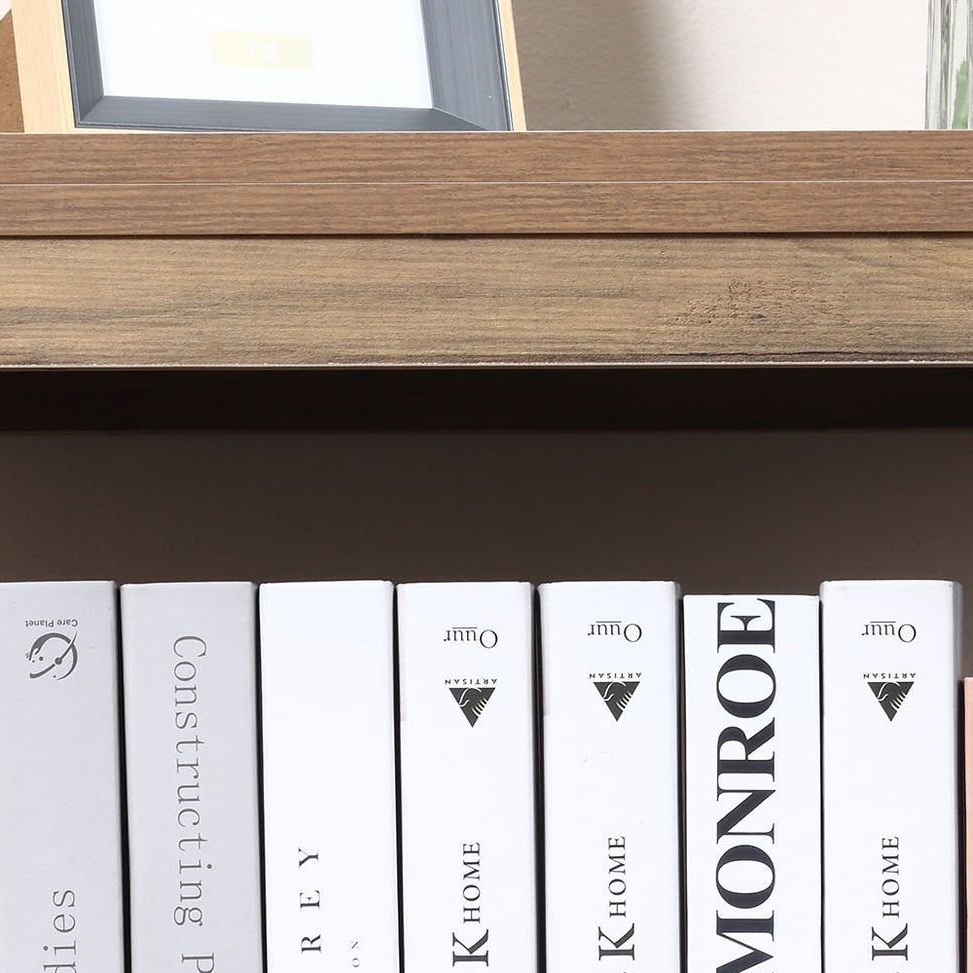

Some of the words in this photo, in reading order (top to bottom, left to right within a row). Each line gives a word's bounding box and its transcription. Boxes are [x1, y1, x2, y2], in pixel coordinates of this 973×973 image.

[24, 618, 54, 628] Planet
[55, 618, 79, 628] Care
[586, 620, 643, 644] Ouur
[860, 620, 918, 644] Ouur
[442, 626, 499, 650] Ouur
[444, 678, 498, 686] ARTISAN
[588, 671, 643, 680] ARTISAN
[862, 672, 917, 680] ARTISAN
[172, 635, 213, 927] Constructing
[461, 841, 482, 925] HOME
[607, 835, 627, 919] HOME
[880, 835, 901, 919] HOME
